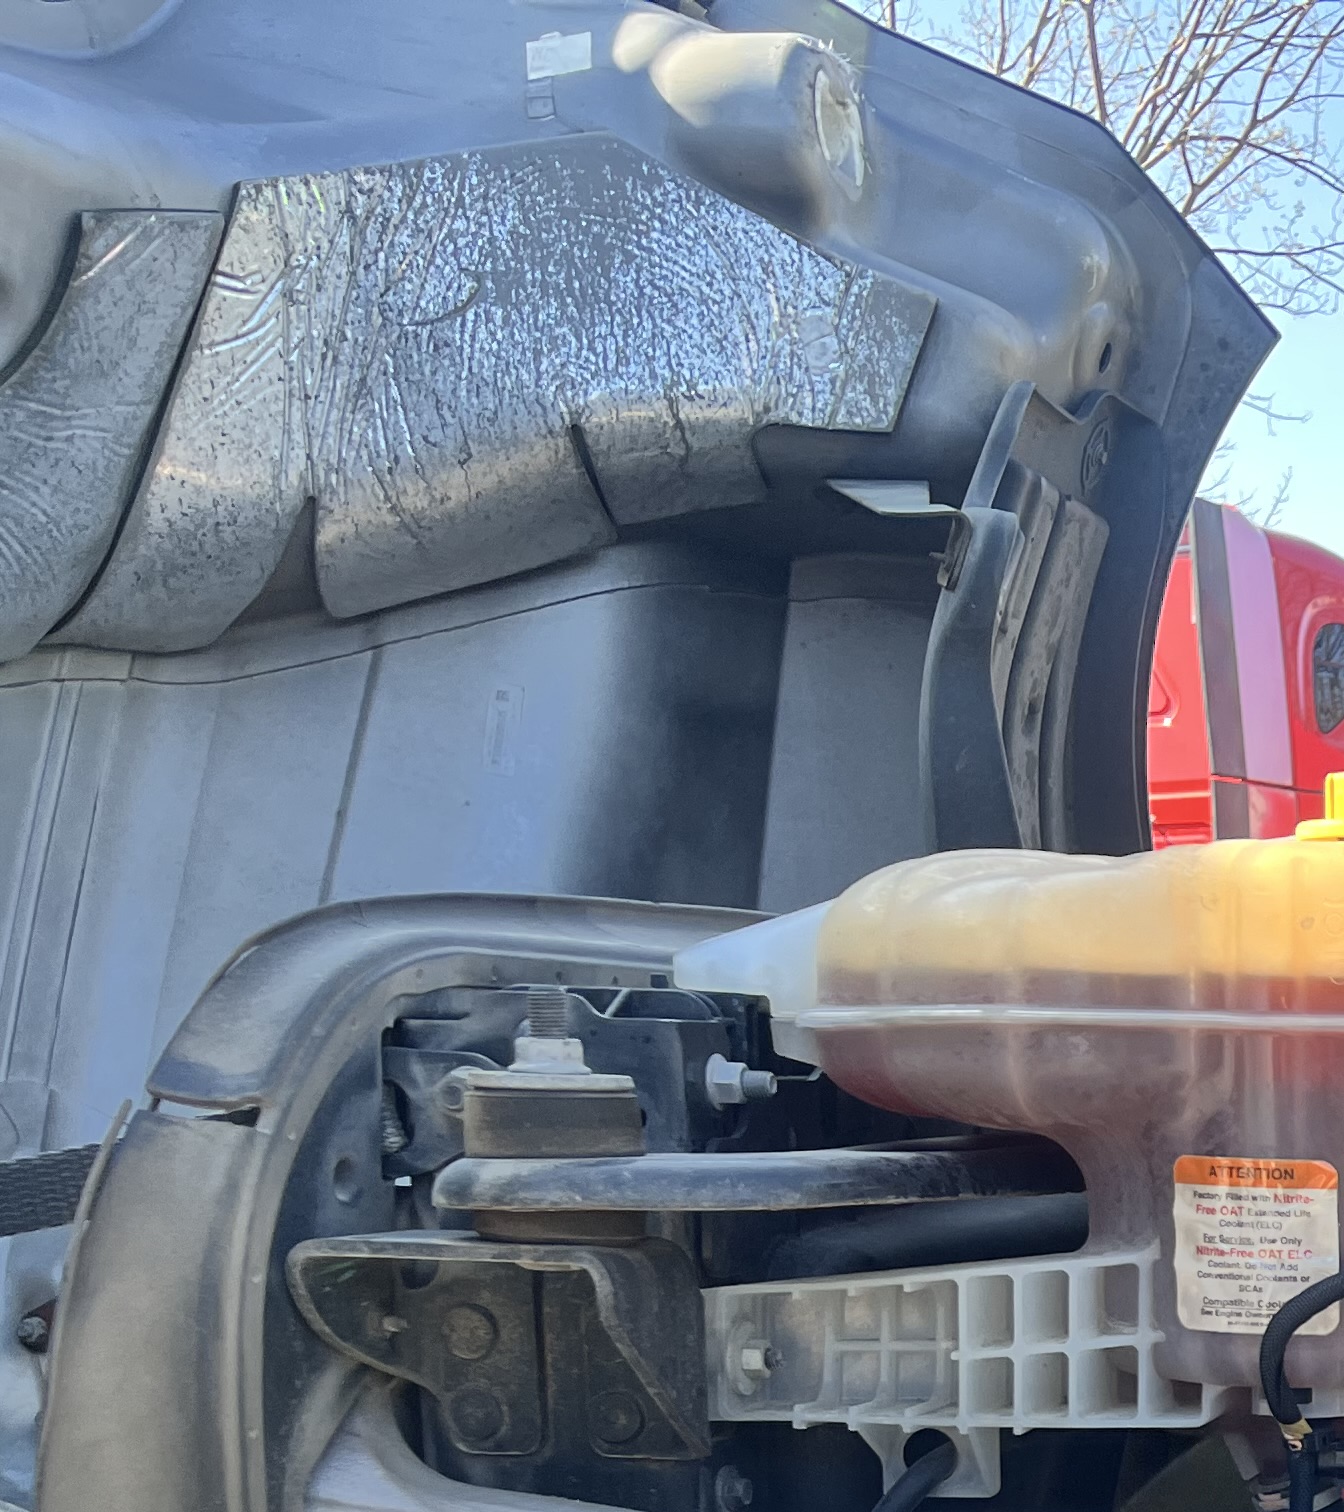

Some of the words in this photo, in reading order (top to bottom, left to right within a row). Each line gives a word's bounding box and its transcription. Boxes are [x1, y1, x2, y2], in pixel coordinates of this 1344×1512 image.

[1209, 1165, 1295, 1181] ATTENTION
[1196, 1203, 1217, 1216] Free
[1219, 1204, 1245, 1217] OAT
[1196, 1245, 1255, 1259] Nitrite-Free
[1257, 1248, 1285, 1260] OAT
[1287, 1249, 1313, 1260] ELC
